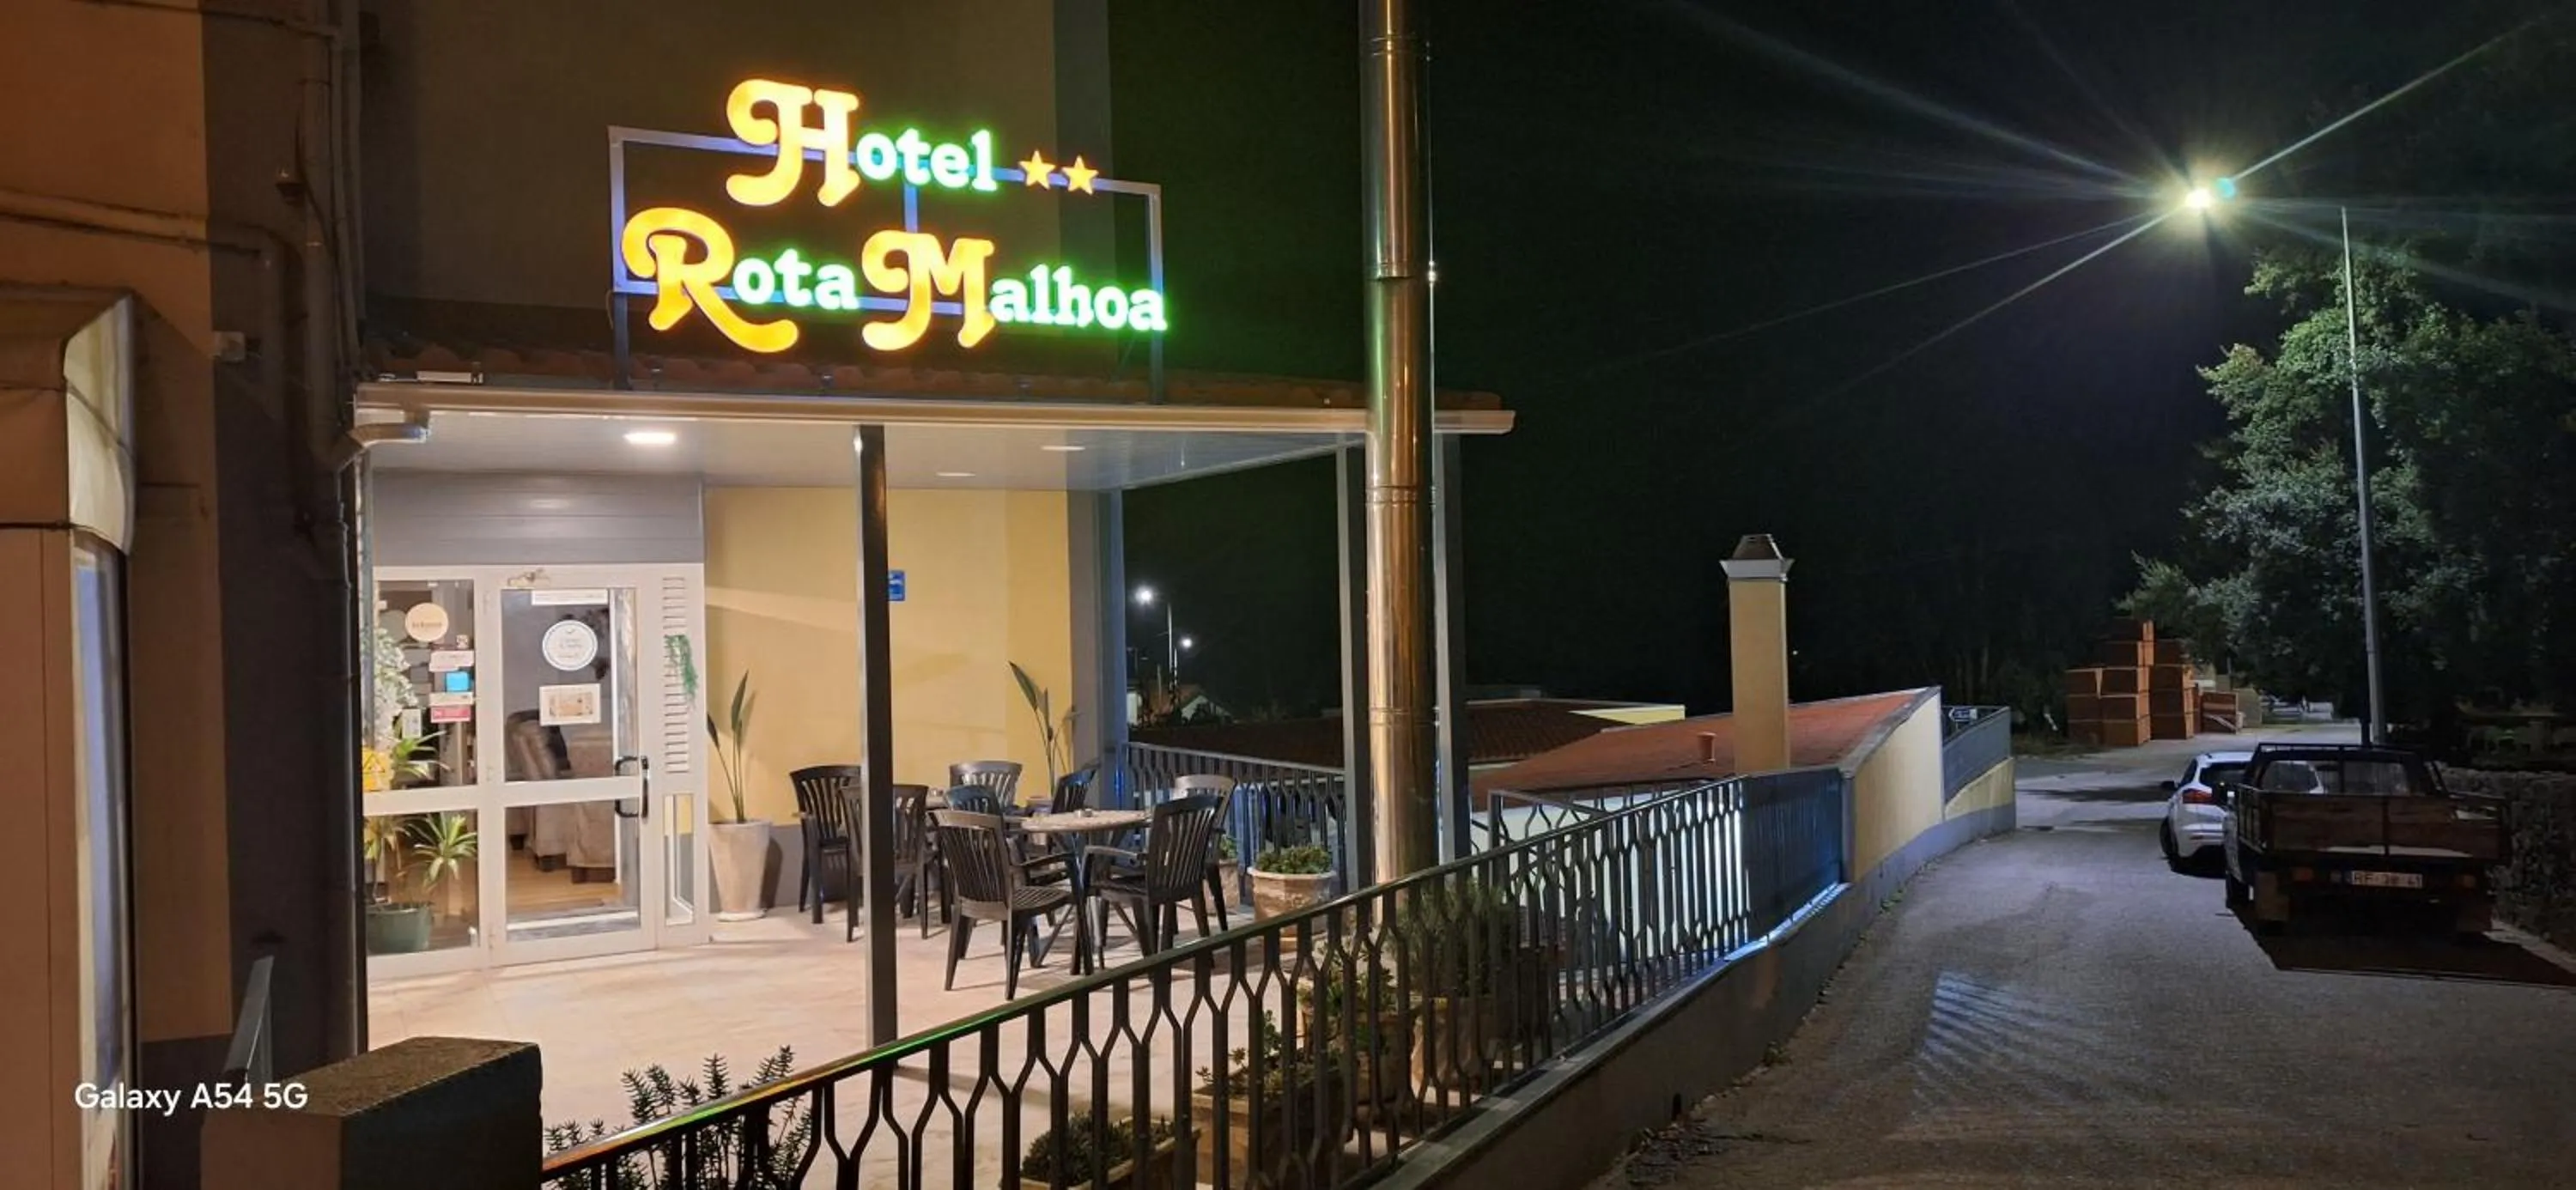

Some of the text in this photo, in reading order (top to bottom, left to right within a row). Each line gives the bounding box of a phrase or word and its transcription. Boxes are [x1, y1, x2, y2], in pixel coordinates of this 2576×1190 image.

[726, 78, 998, 208] Hotel
[621, 207, 1168, 353] Rota Malhoa
